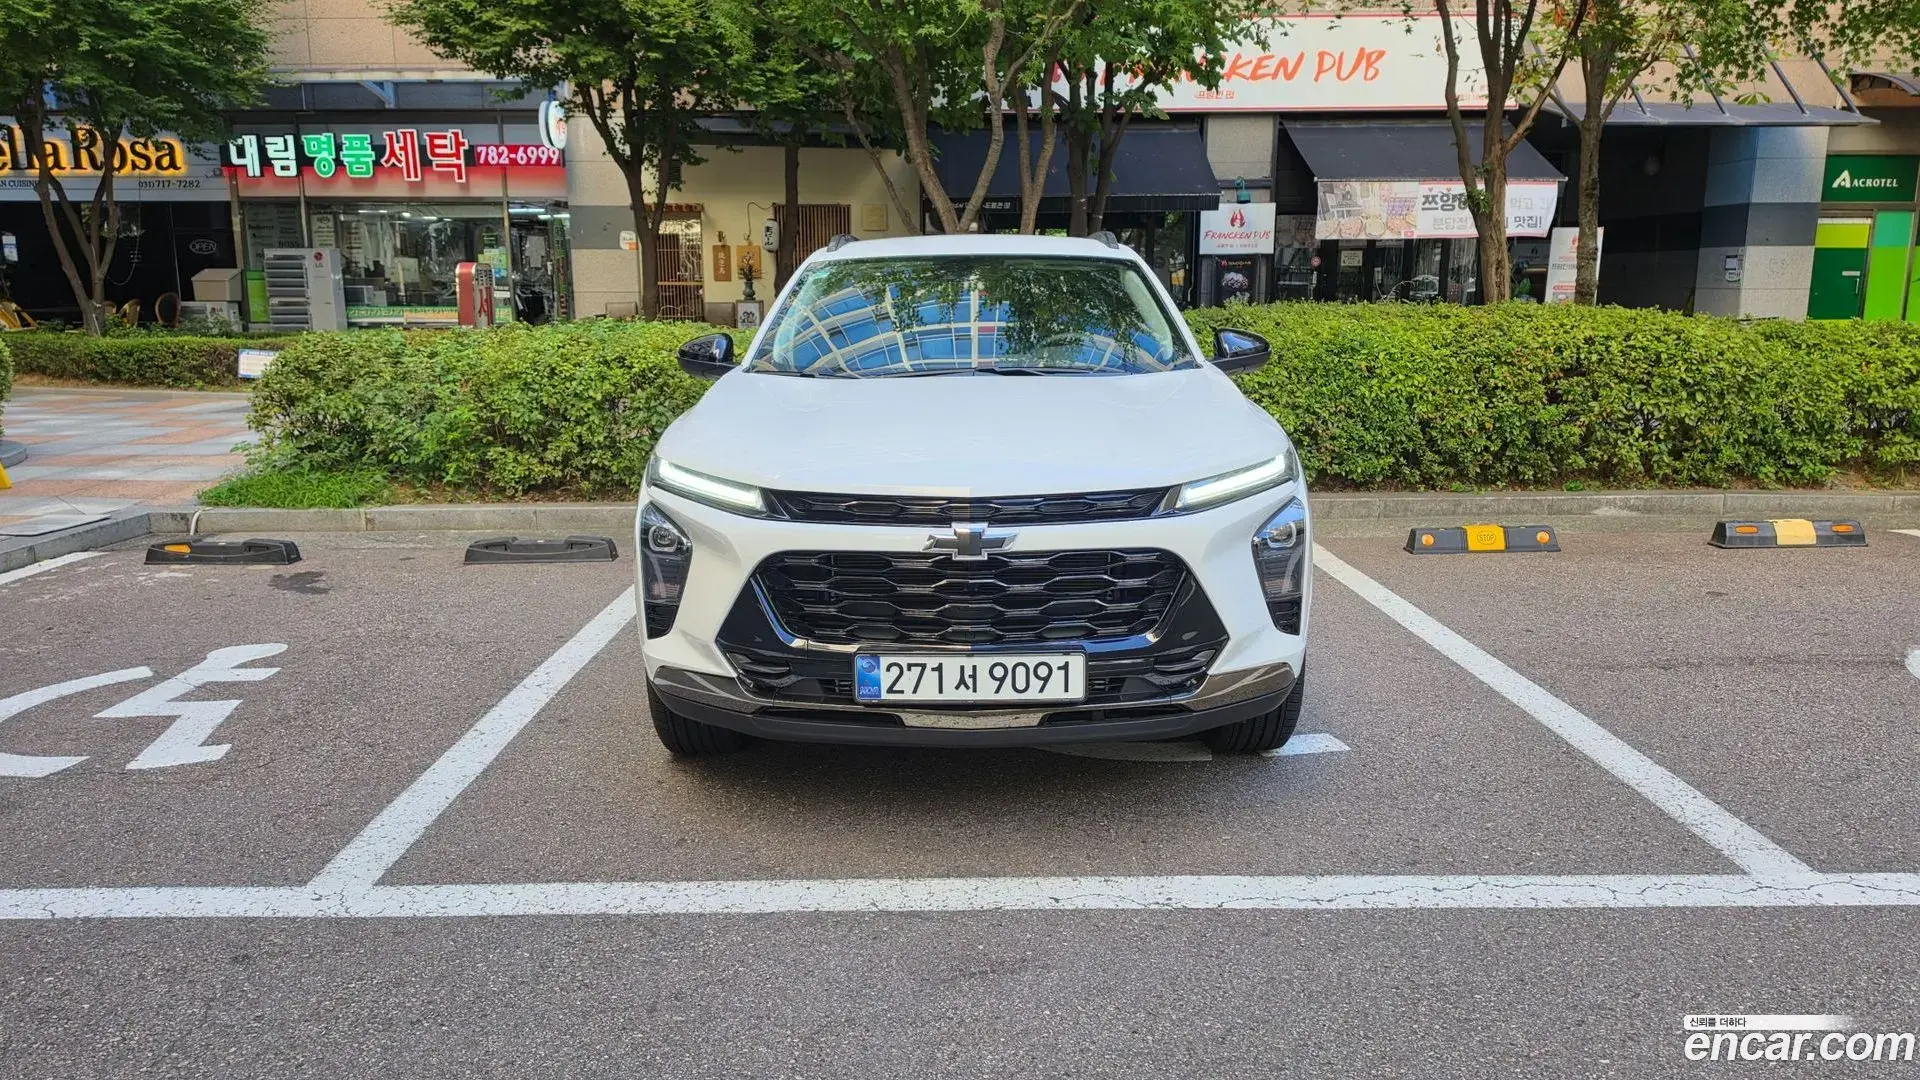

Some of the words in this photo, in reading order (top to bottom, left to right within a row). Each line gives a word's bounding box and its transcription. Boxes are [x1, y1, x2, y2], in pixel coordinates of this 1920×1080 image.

[1313, 47, 1386, 82] PUB
[477, 145, 560, 165] 782-6999
[1852, 178, 1899, 188] ACROTEL
[1514, 215, 1542, 228] 맛집!
[1204, 230, 1252, 240] FRANCKEN
[1253, 230, 1272, 240] PUB
[988, 660, 1070, 694] 9091
